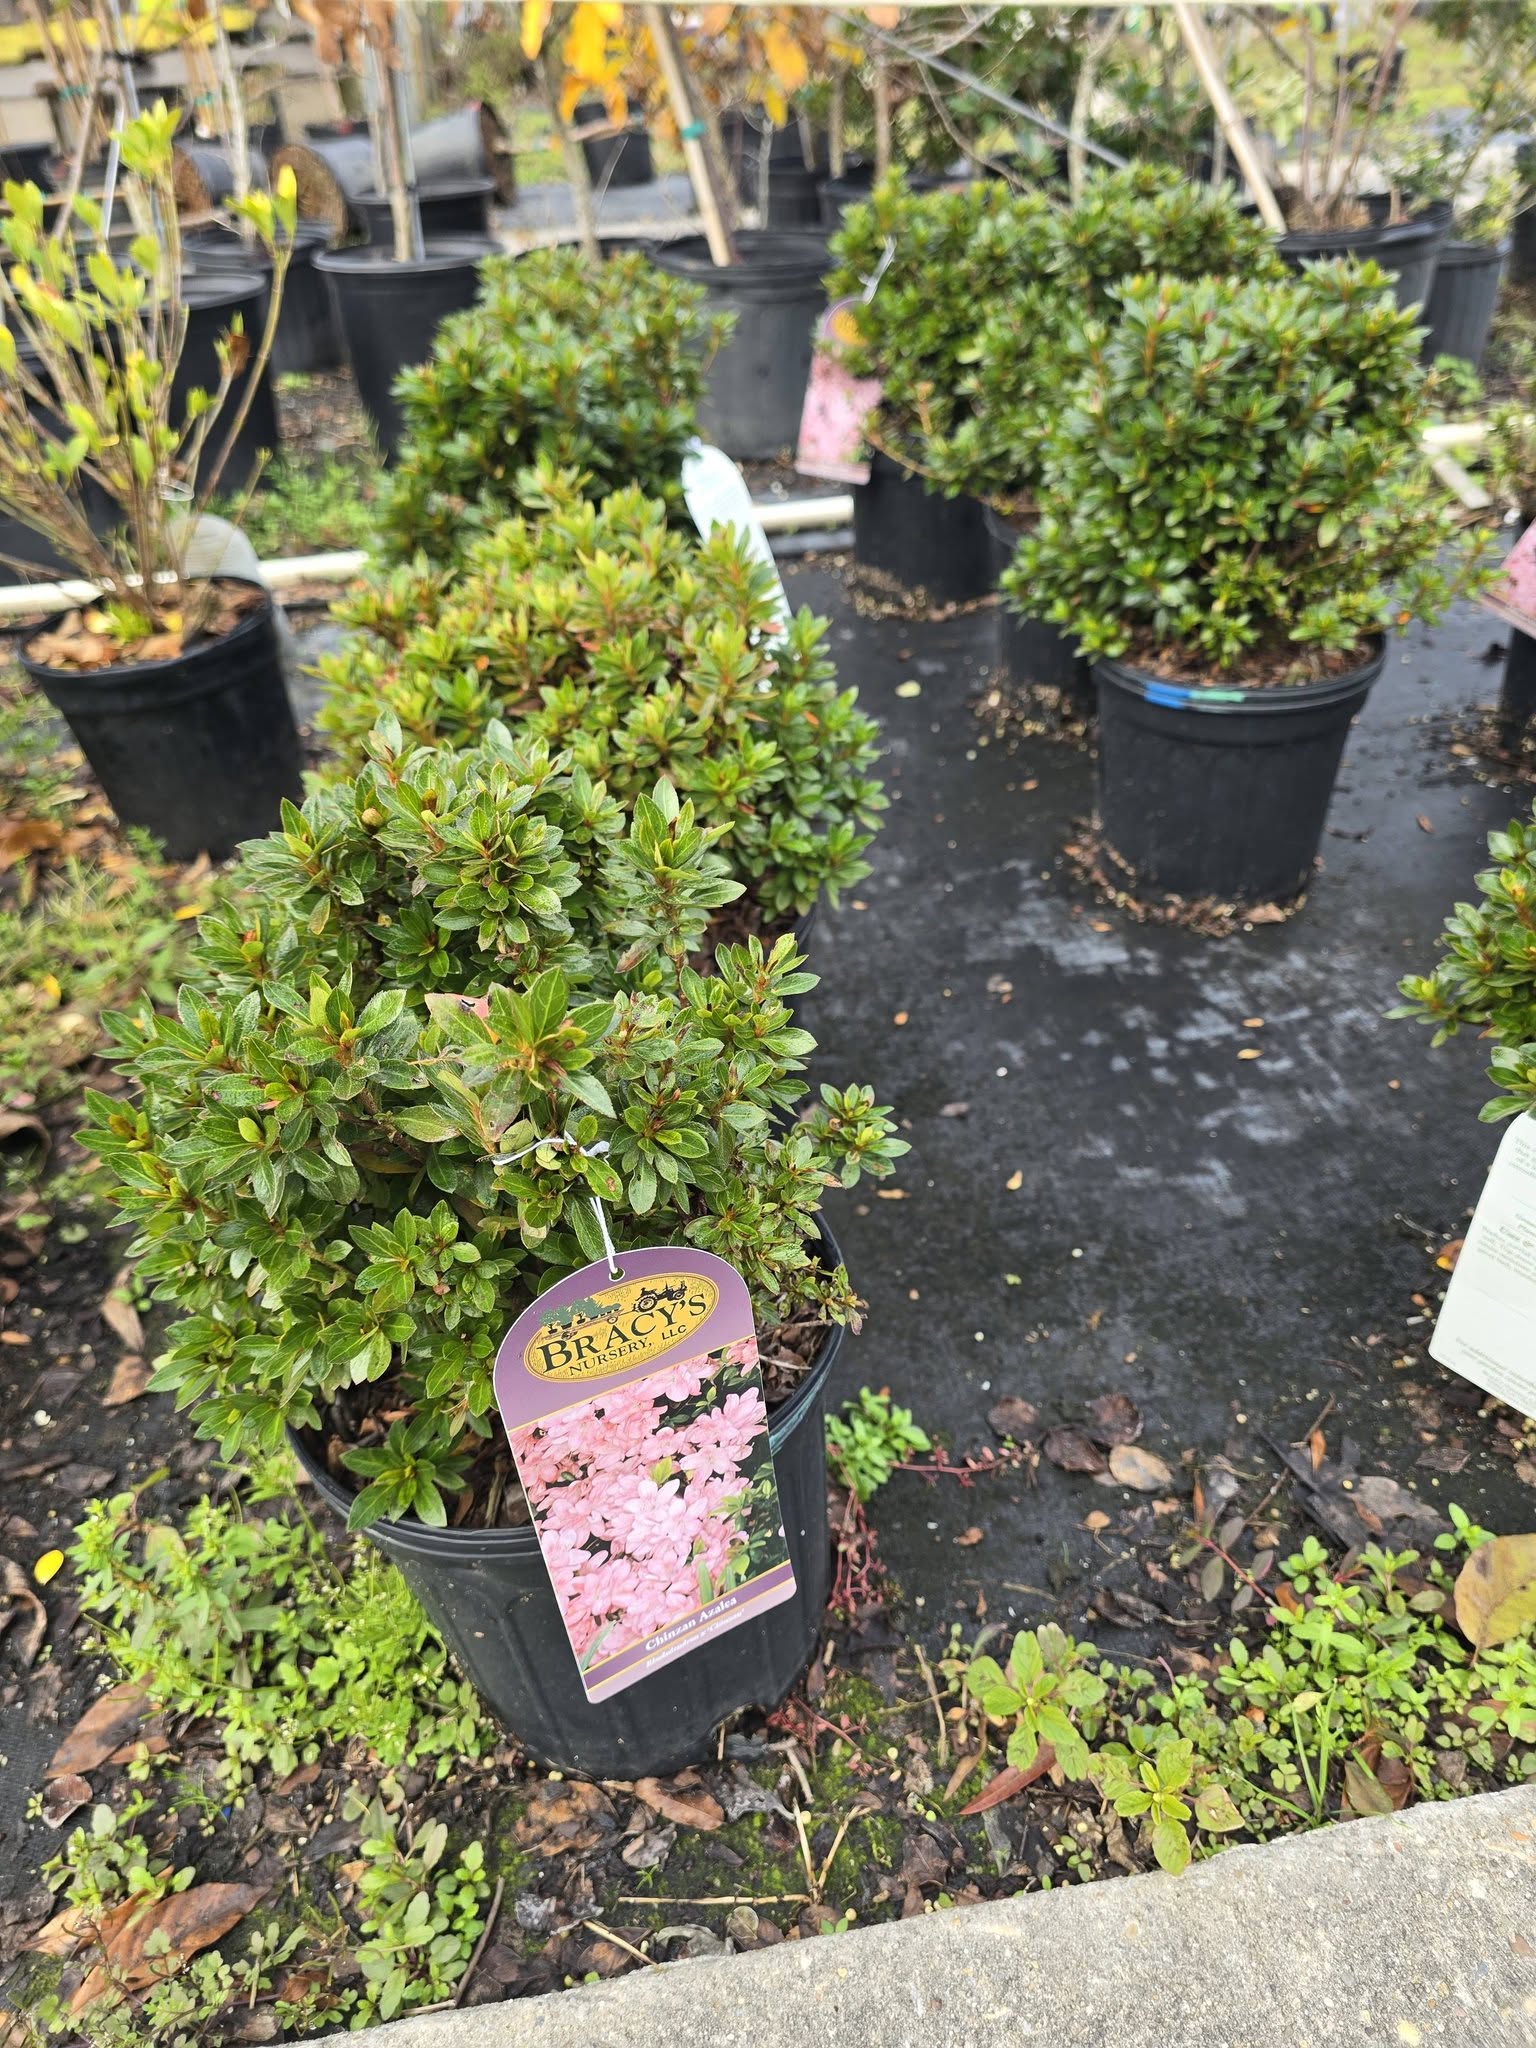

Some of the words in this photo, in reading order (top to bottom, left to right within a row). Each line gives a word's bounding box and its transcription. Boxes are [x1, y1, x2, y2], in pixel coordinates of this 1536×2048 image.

[536, 1293, 707, 1373] BRACY'S
[569, 1340, 652, 1376] NURSERY,
[662, 1324, 687, 1341] LLC
[645, 1619, 696, 1651] Chinzan
[699, 1596, 737, 1623] Azalea
